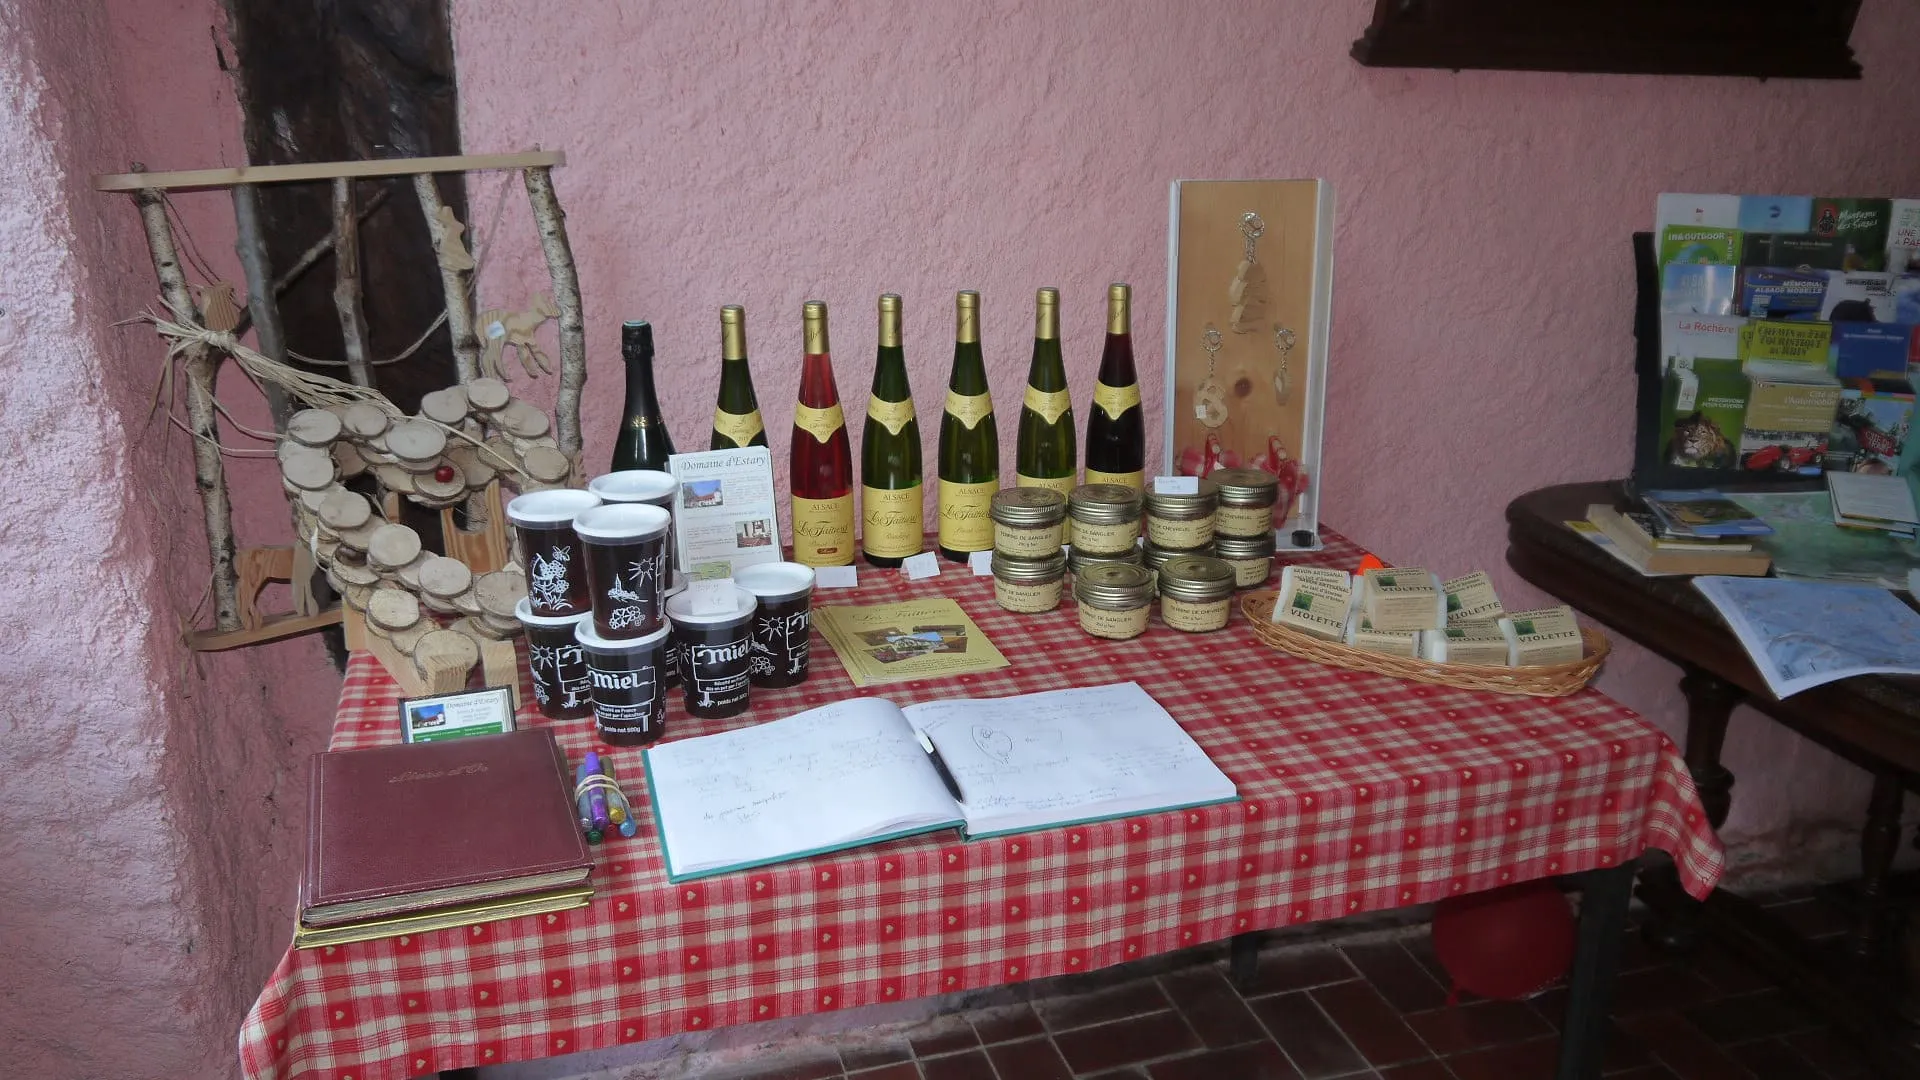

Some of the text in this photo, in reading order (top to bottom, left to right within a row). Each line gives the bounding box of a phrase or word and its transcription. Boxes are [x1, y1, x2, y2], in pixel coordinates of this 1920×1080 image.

[1678, 321, 1691, 330] La
[681, 455, 766, 471] Domaine d'Estary
[959, 487, 985, 495] ALSACE
[810, 503, 840, 511] ALSACE
[1319, 582, 1350, 594] ARTISANAL
[1448, 600, 1502, 621] VIOLETTE
[1291, 608, 1344, 629] VIOLETTE
[1518, 630, 1576, 642] VIOLETTE
[697, 639, 750, 665] Miel
[587, 670, 639, 690] Miel
